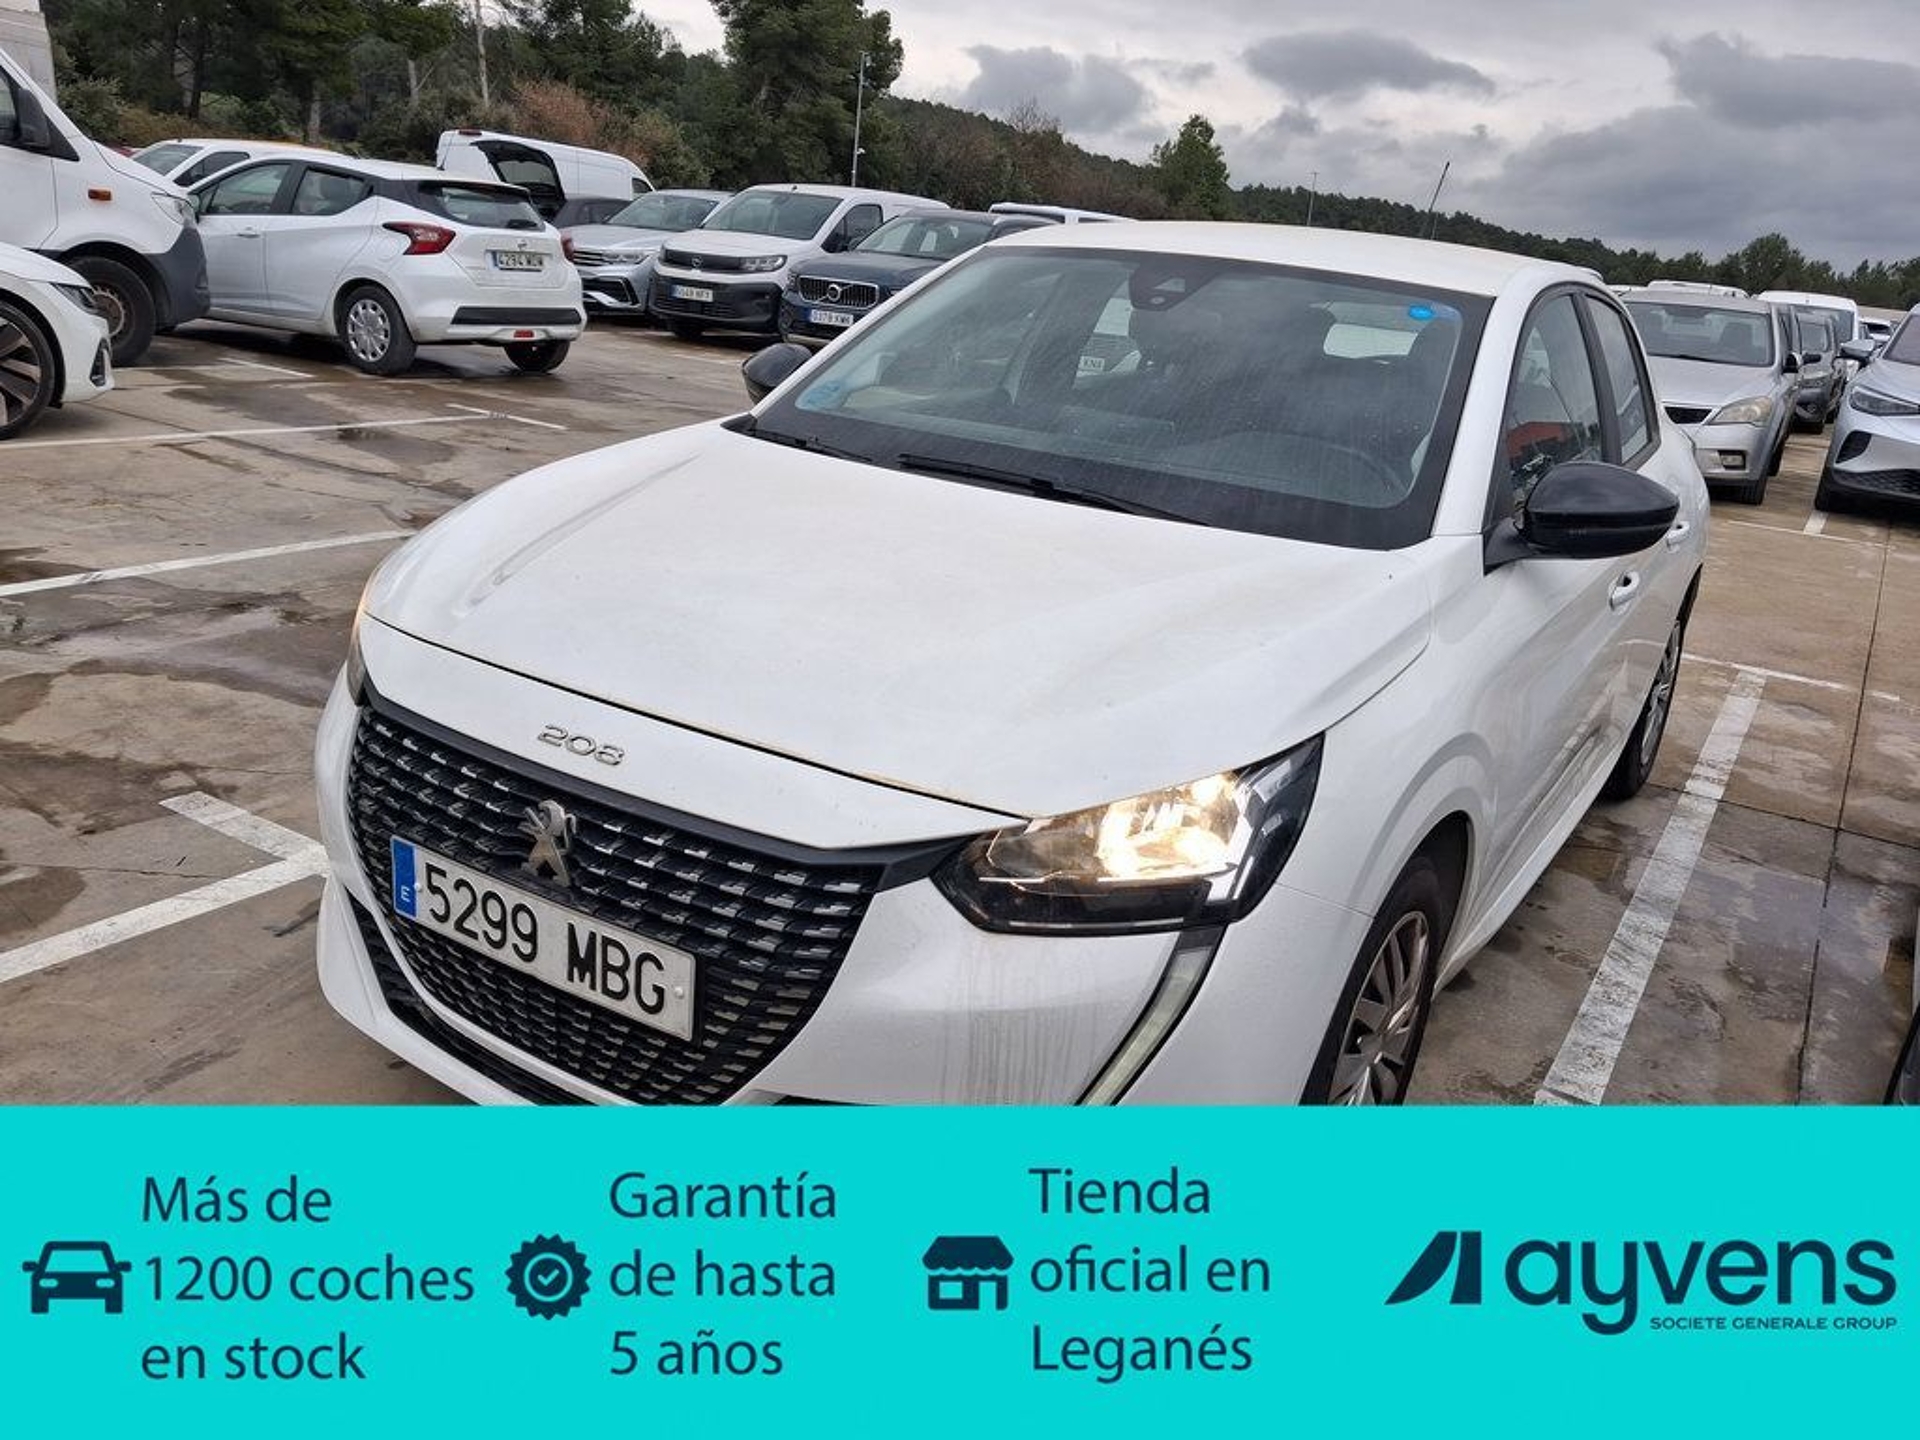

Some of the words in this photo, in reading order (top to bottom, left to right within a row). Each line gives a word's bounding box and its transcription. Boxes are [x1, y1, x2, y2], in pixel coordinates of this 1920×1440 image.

[537, 724, 625, 766] 208
[401, 885, 411, 902] E
[424, 862, 538, 963] 5299
[566, 921, 666, 1015] MBG
